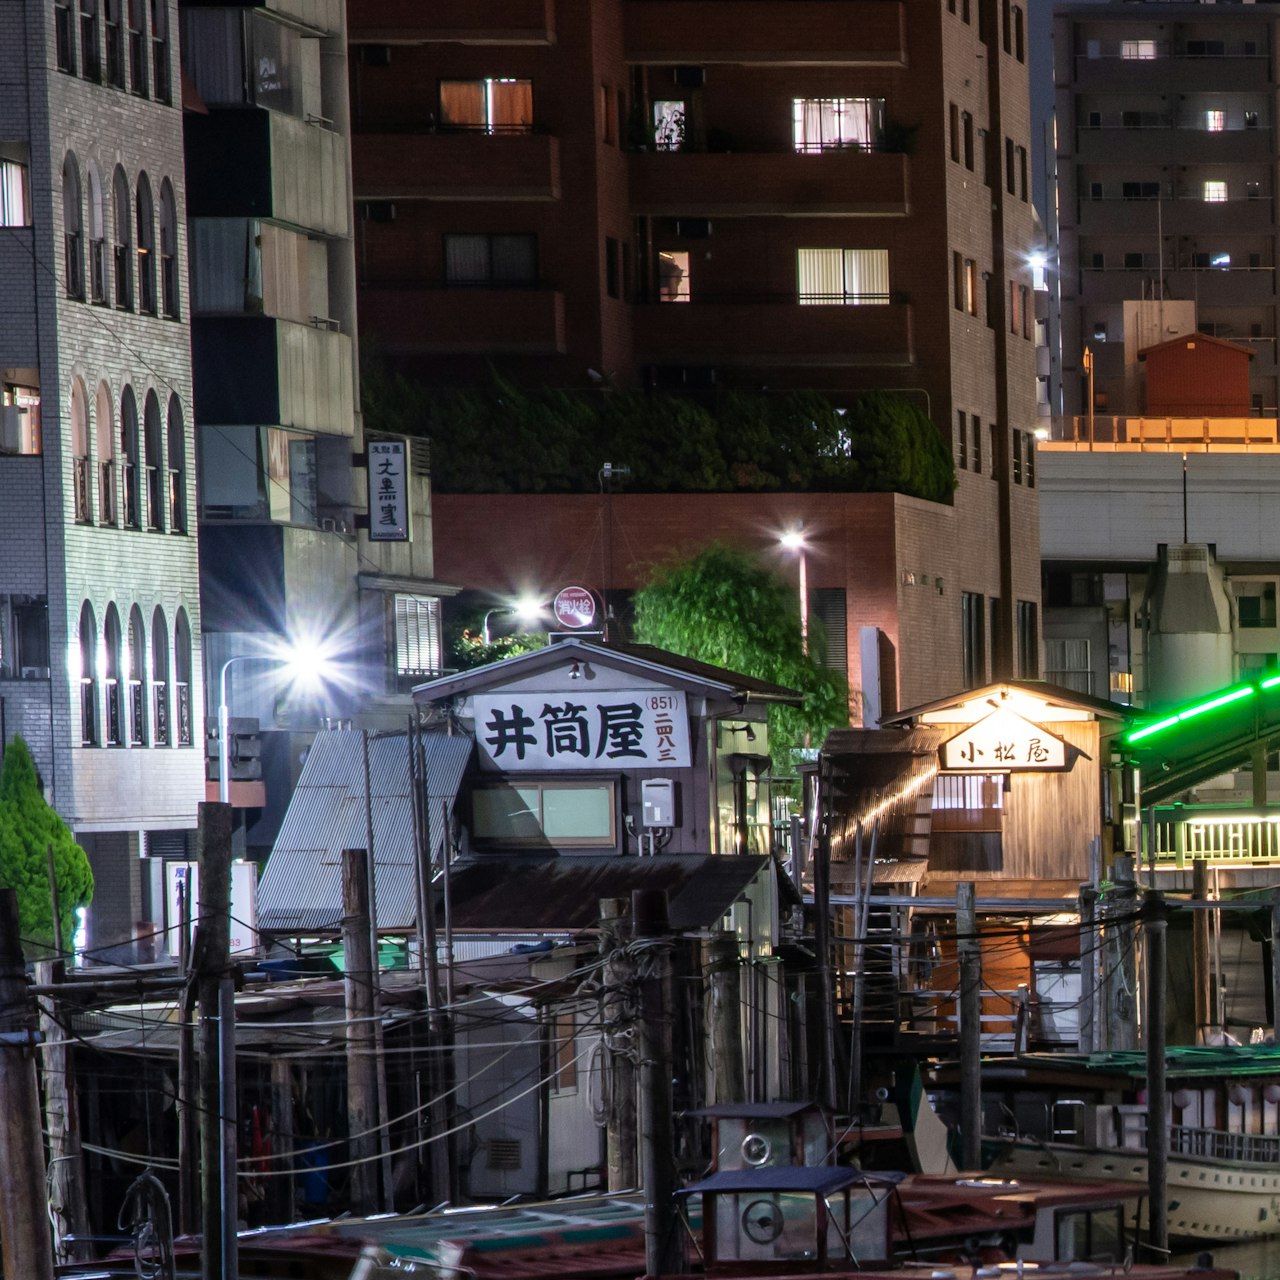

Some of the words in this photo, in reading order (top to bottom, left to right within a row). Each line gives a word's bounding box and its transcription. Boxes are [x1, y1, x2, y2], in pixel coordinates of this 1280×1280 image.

[558, 599, 592, 615] 消火栓
[645, 696, 679, 711] (851)
[485, 701, 648, 761] 井筒屋
[654, 712, 677, 762] 二四八三
[960, 738, 1049, 763] 小松屋
